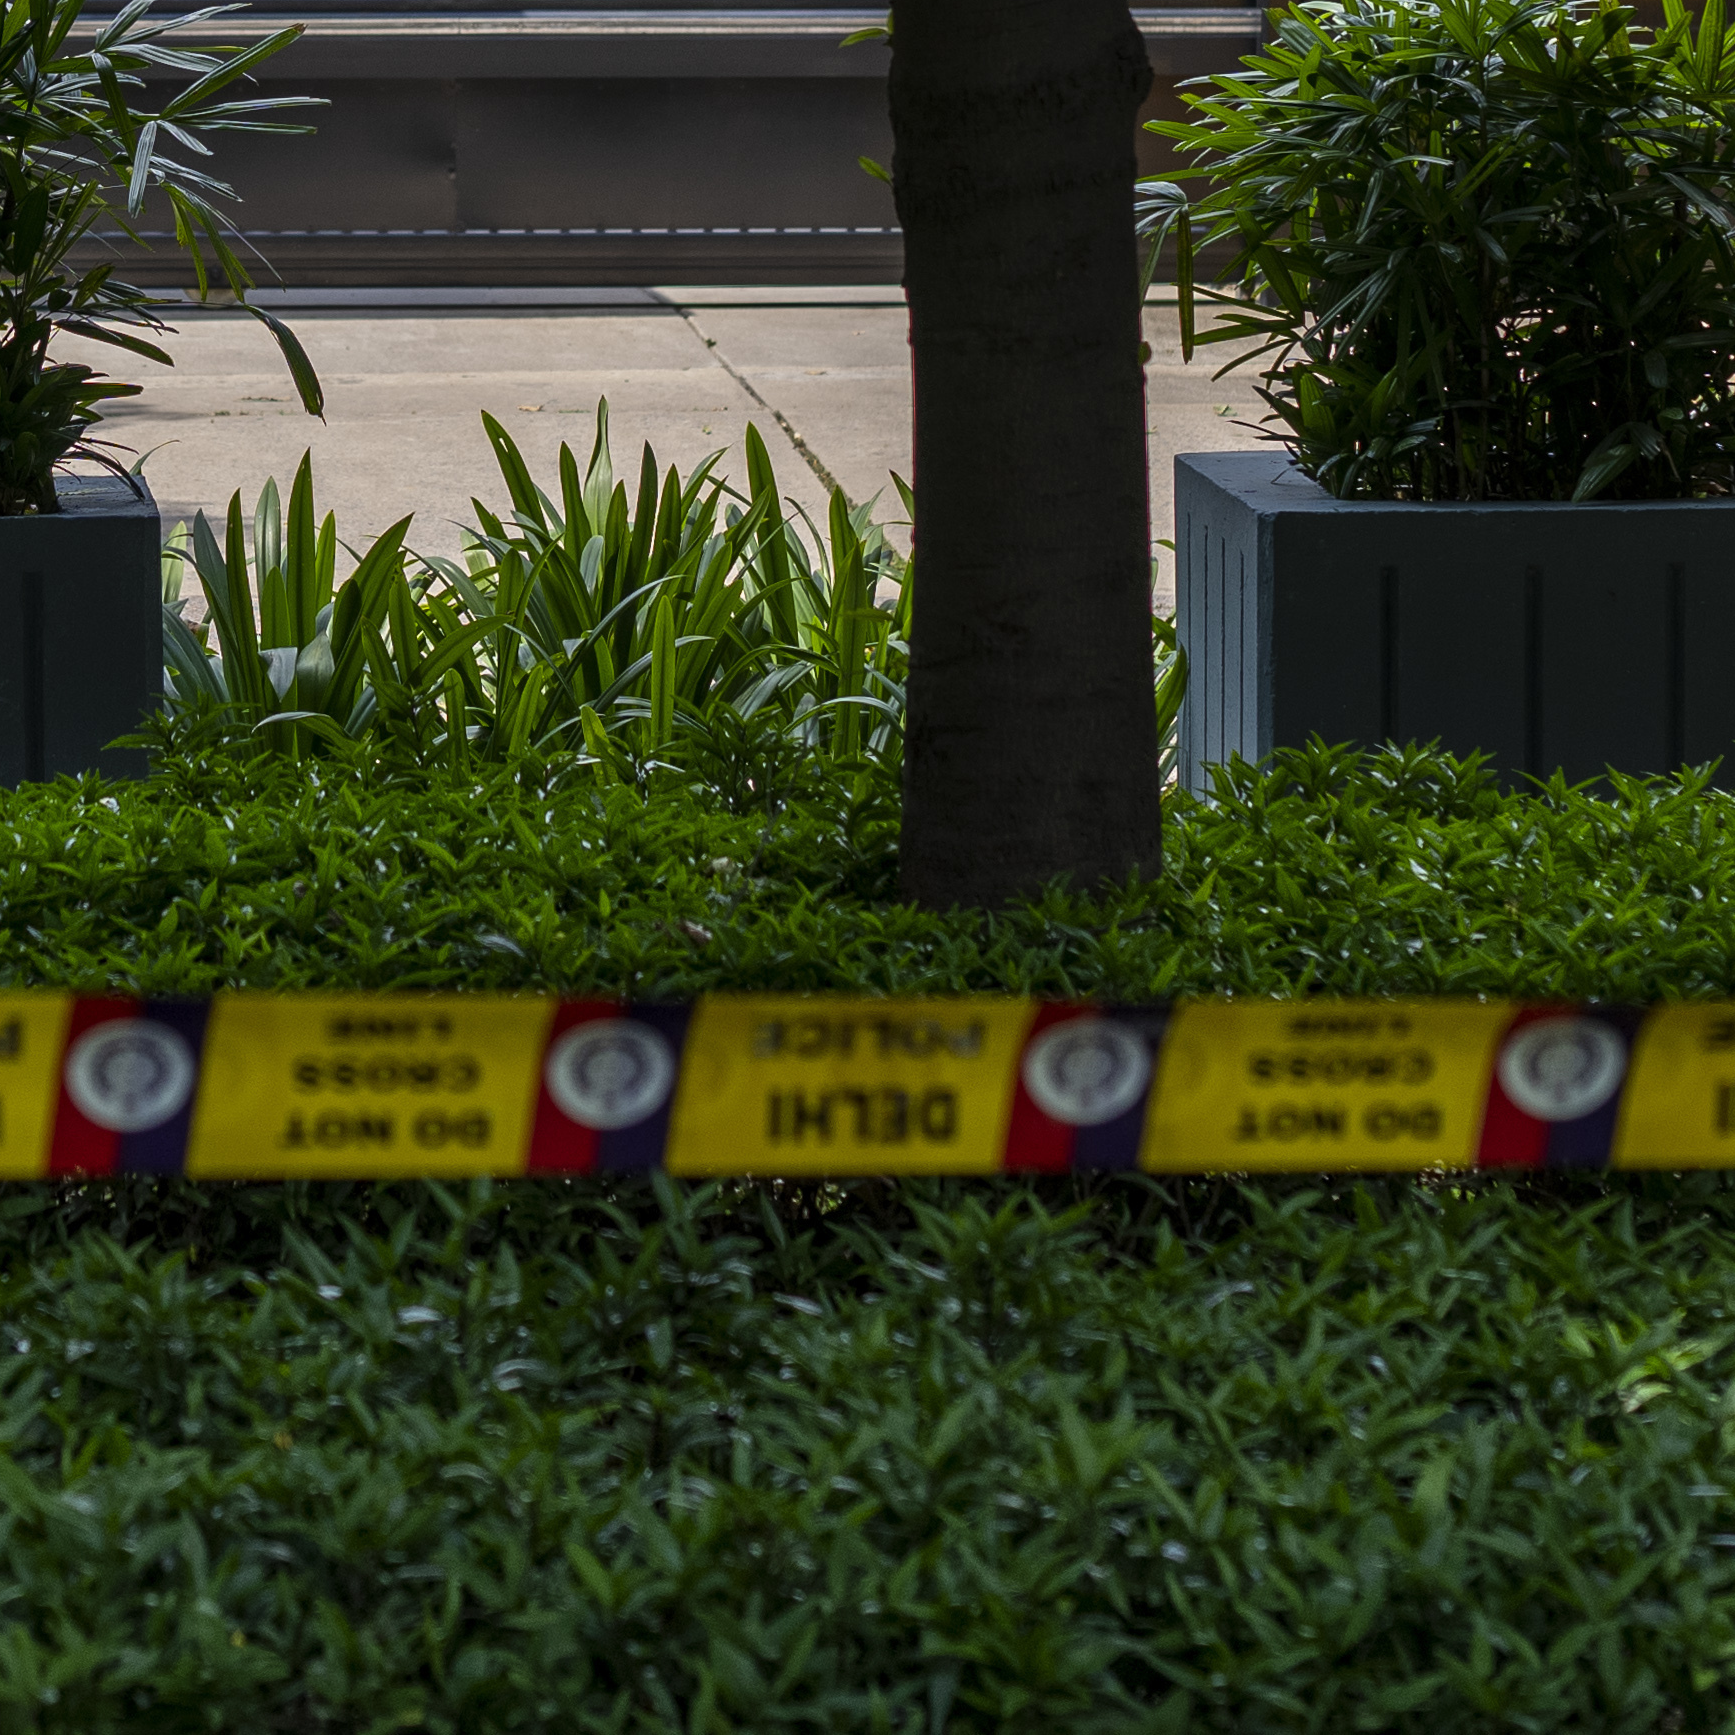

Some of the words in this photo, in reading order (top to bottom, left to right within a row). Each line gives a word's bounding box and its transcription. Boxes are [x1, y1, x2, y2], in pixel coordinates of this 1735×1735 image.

[750, 1009, 989, 1059] POLICE
[279, 1109, 392, 1151] NOT
[413, 1109, 493, 1149] DO
[765, 1082, 959, 1147] DELHI
[1232, 1102, 1346, 1144] NOT
[1365, 1102, 1444, 1142] DO
